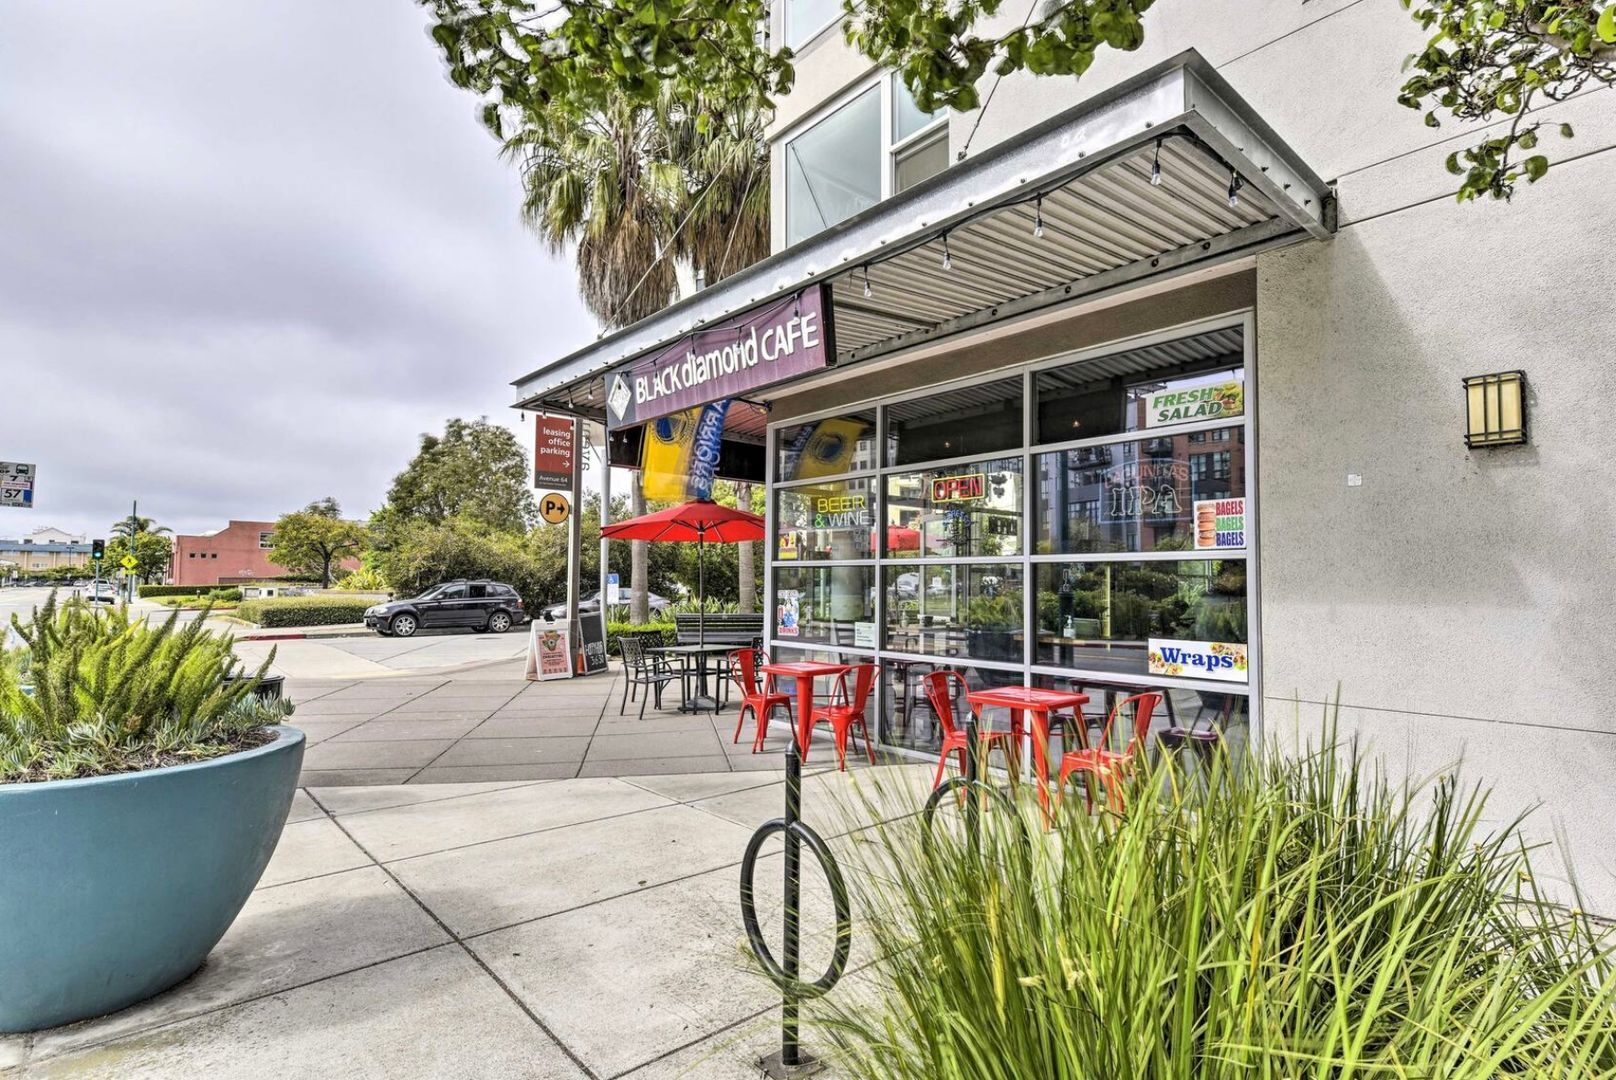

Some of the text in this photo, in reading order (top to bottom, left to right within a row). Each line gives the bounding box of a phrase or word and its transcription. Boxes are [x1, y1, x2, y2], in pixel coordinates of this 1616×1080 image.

[636, 311, 819, 404] BLACK diamond CAFE
[1153, 387, 1214, 409] FRESH
[1157, 402, 1223, 422] SALAD
[543, 427, 571, 440] leasing
[548, 437, 571, 447] office
[540, 447, 570, 458] parking
[4, 489, 21, 498] 57
[934, 476, 982, 499] OPEN
[545, 500, 555, 515] P
[817, 494, 866, 513] BEER
[1111, 484, 1183, 516] IPA
[1216, 500, 1244, 516] BAGELS
[814, 510, 870, 528] & WINE
[1216, 516, 1244, 531] BAGELS
[1216, 531, 1244, 546] BAGELS
[1160, 647, 1233, 671] Wraps
